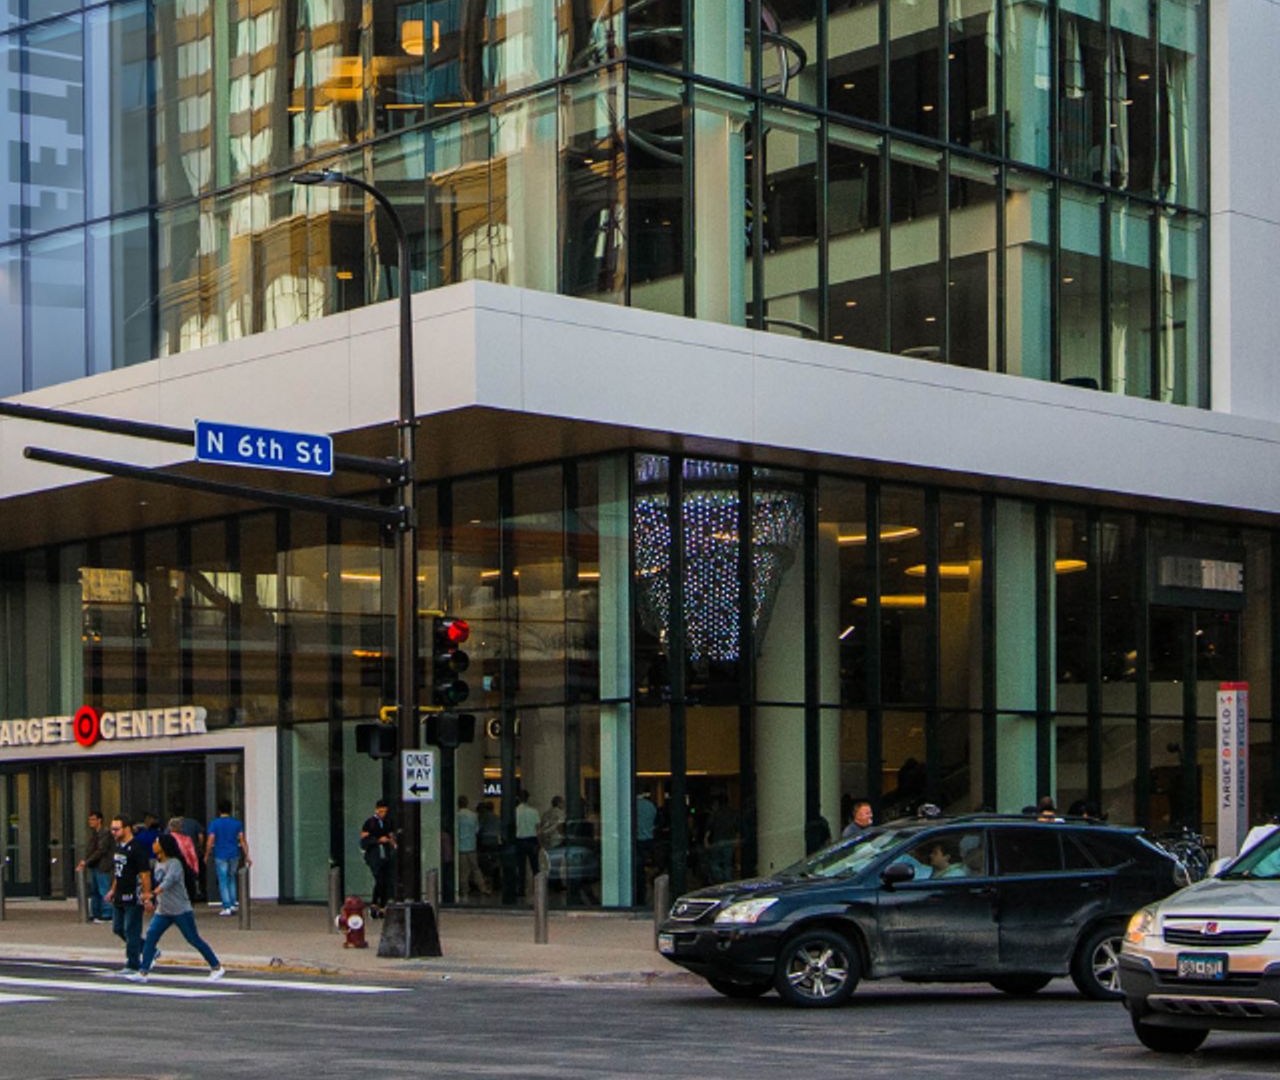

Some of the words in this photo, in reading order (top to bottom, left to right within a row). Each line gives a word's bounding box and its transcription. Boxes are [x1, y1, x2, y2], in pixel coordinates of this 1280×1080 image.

[207, 430, 224, 454] N
[238, 434, 283, 461] 6th
[296, 441, 323, 465] St
[100, 706, 208, 740] CENTER
[1222, 708, 1231, 747] FIELD
[406, 753, 431, 767] ONE
[406, 767, 432, 780] WAY
[1222, 760, 1231, 809] TARGET
